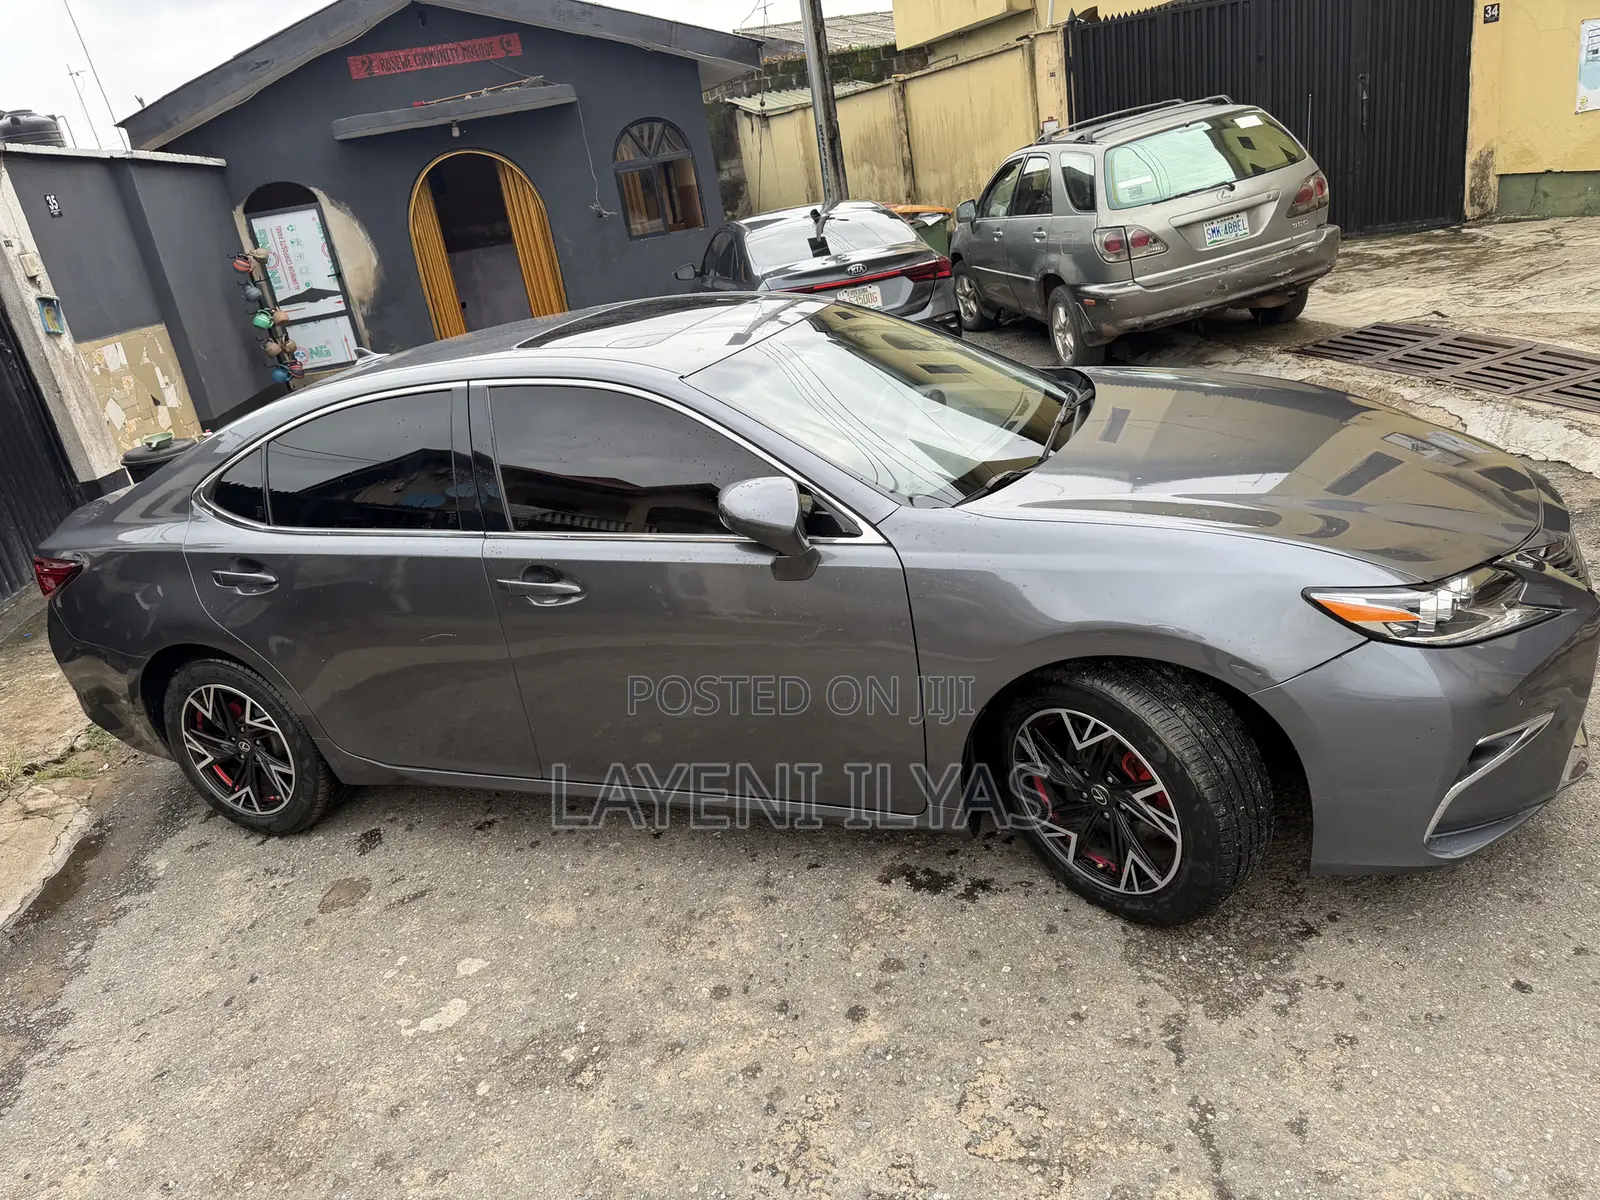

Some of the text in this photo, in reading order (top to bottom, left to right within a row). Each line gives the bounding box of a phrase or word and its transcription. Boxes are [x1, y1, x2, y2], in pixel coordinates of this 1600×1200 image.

[1485, 4, 1499, 18] 34
[414, 49, 459, 67] COMMUNITY
[46, 195, 59, 210] 35
[849, 265, 867, 275] KIA
